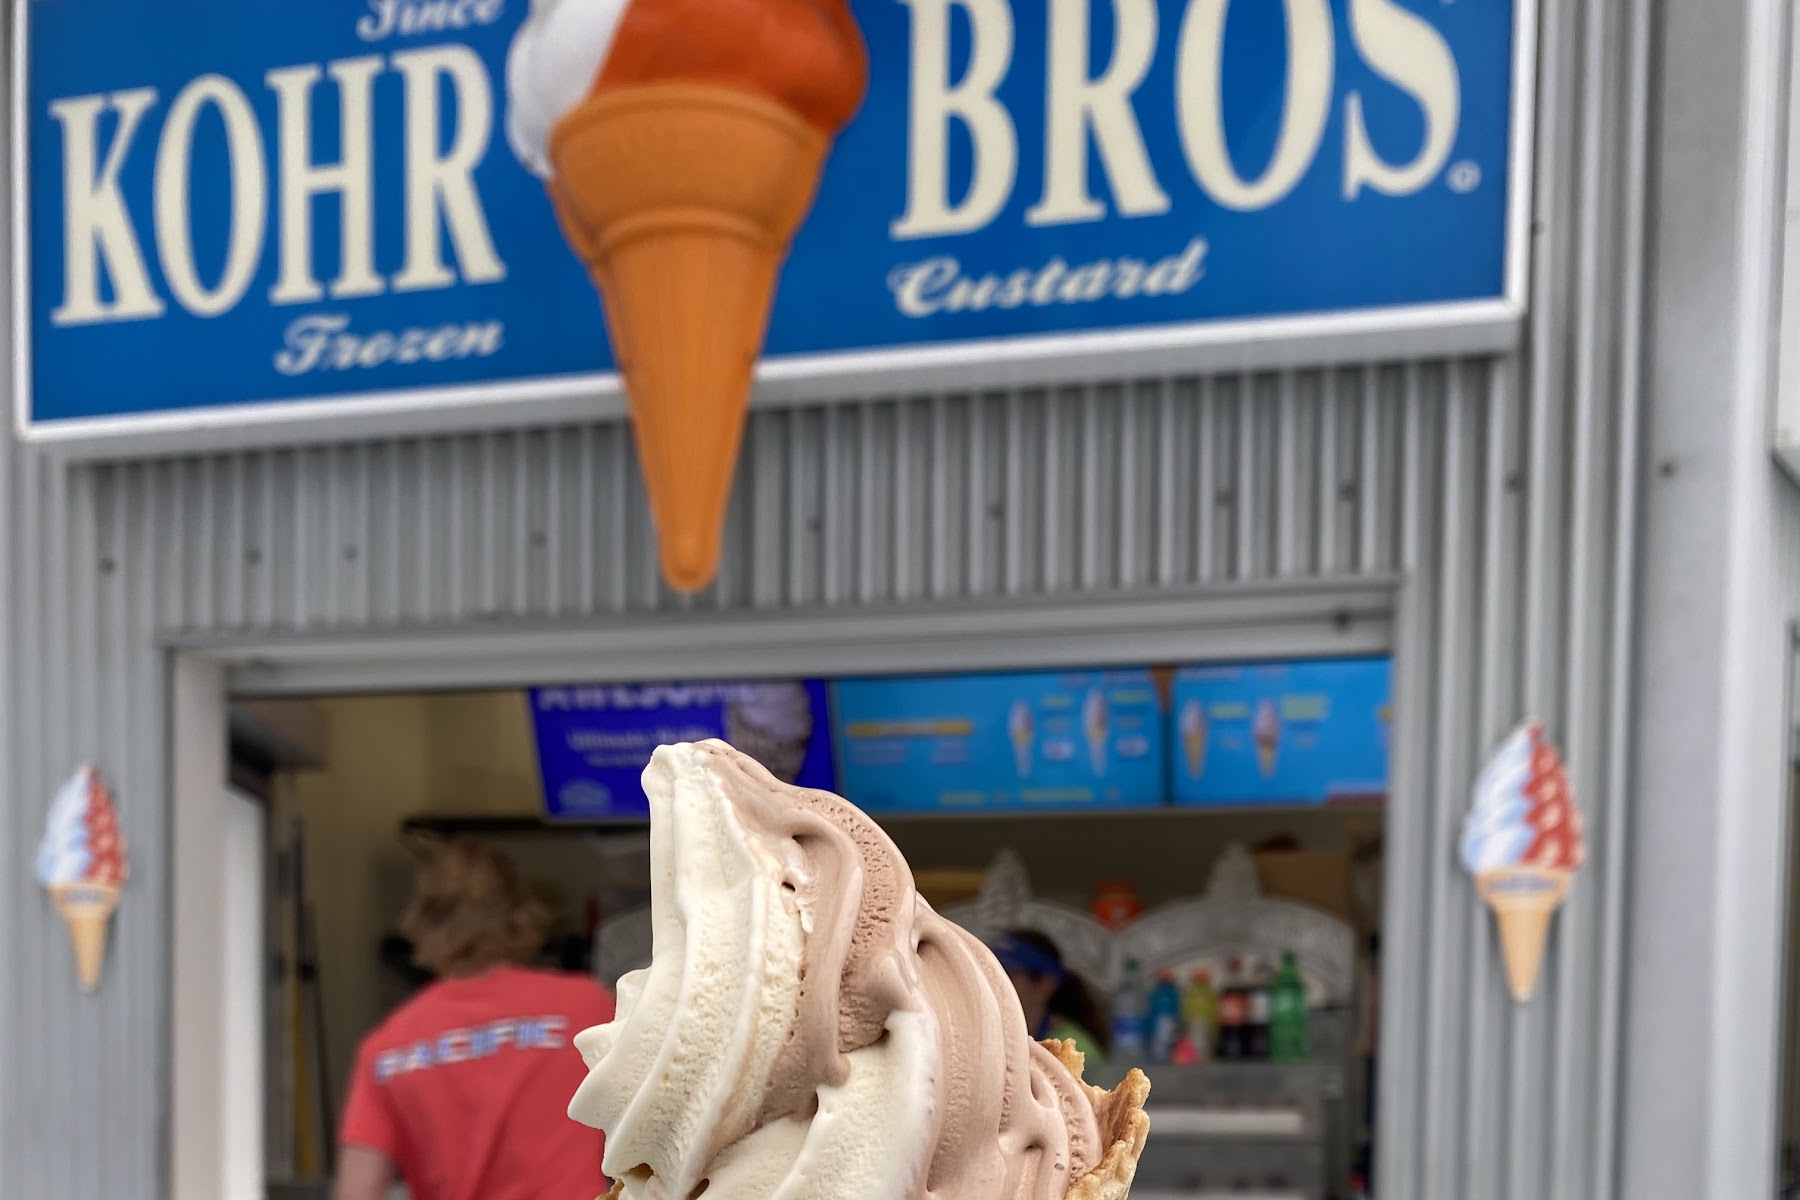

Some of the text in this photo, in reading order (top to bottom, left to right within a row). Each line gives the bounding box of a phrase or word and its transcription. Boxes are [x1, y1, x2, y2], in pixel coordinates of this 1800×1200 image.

[51, 0, 1461, 326] KOHR BROS
[275, 238, 1208, 375] Frozen Custard
